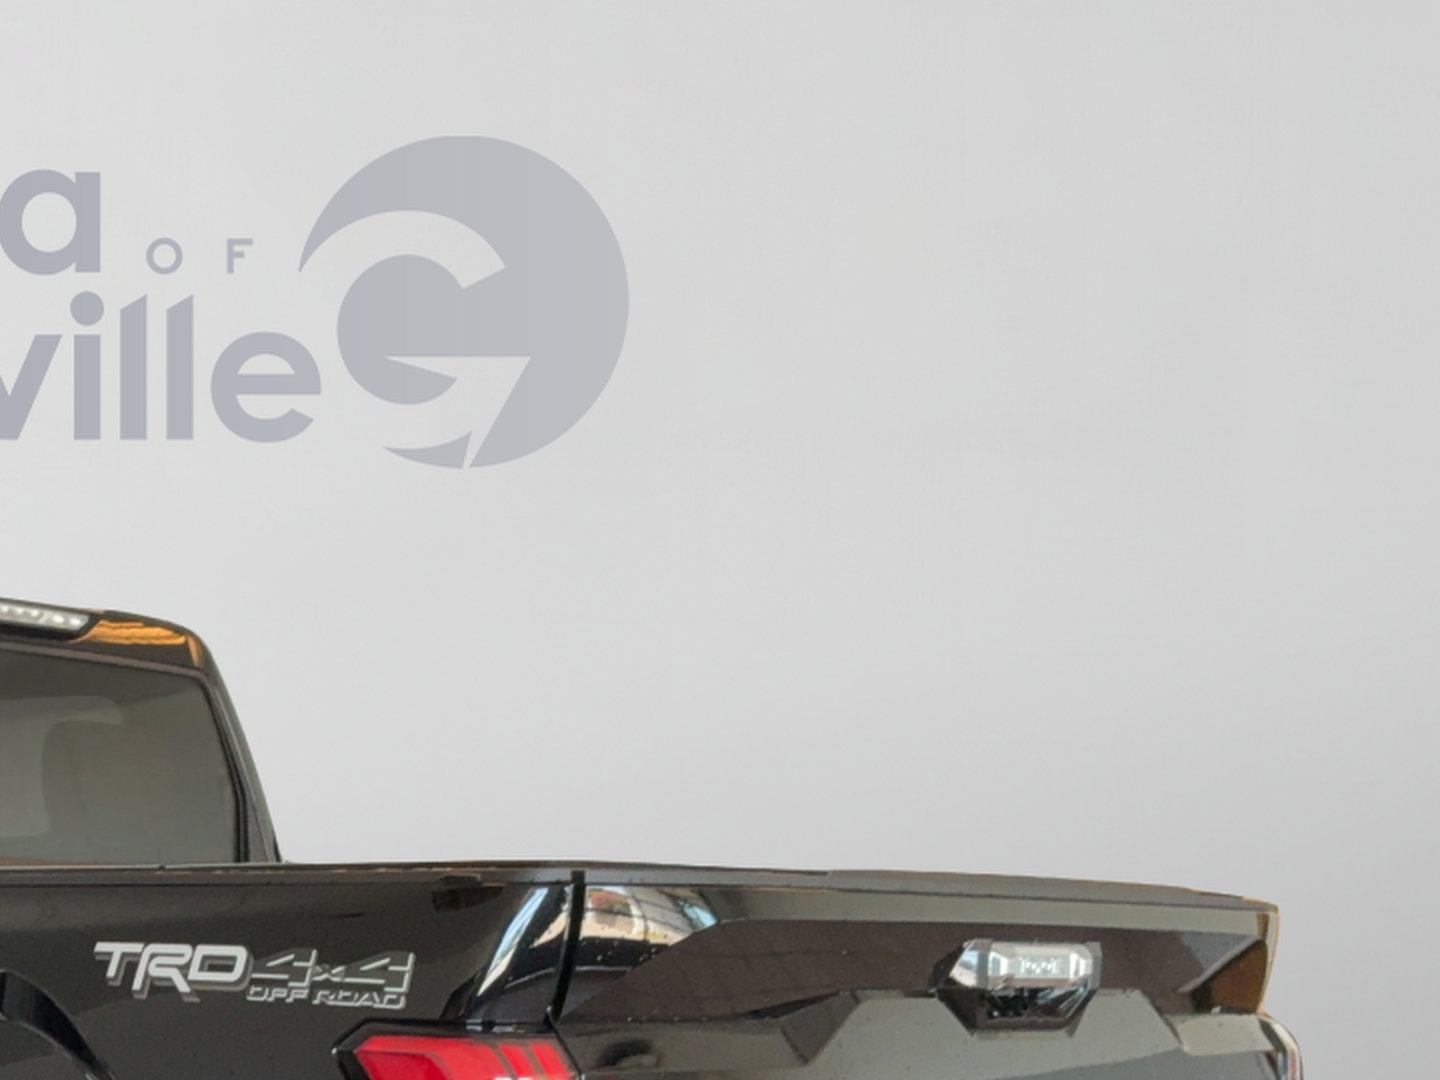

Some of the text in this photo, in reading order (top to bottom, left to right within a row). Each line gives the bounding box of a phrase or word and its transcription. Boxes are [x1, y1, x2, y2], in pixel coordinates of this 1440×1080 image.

[93, 941, 415, 1002] TRD 4x4
[246, 984, 407, 1010] OFF ROAD
